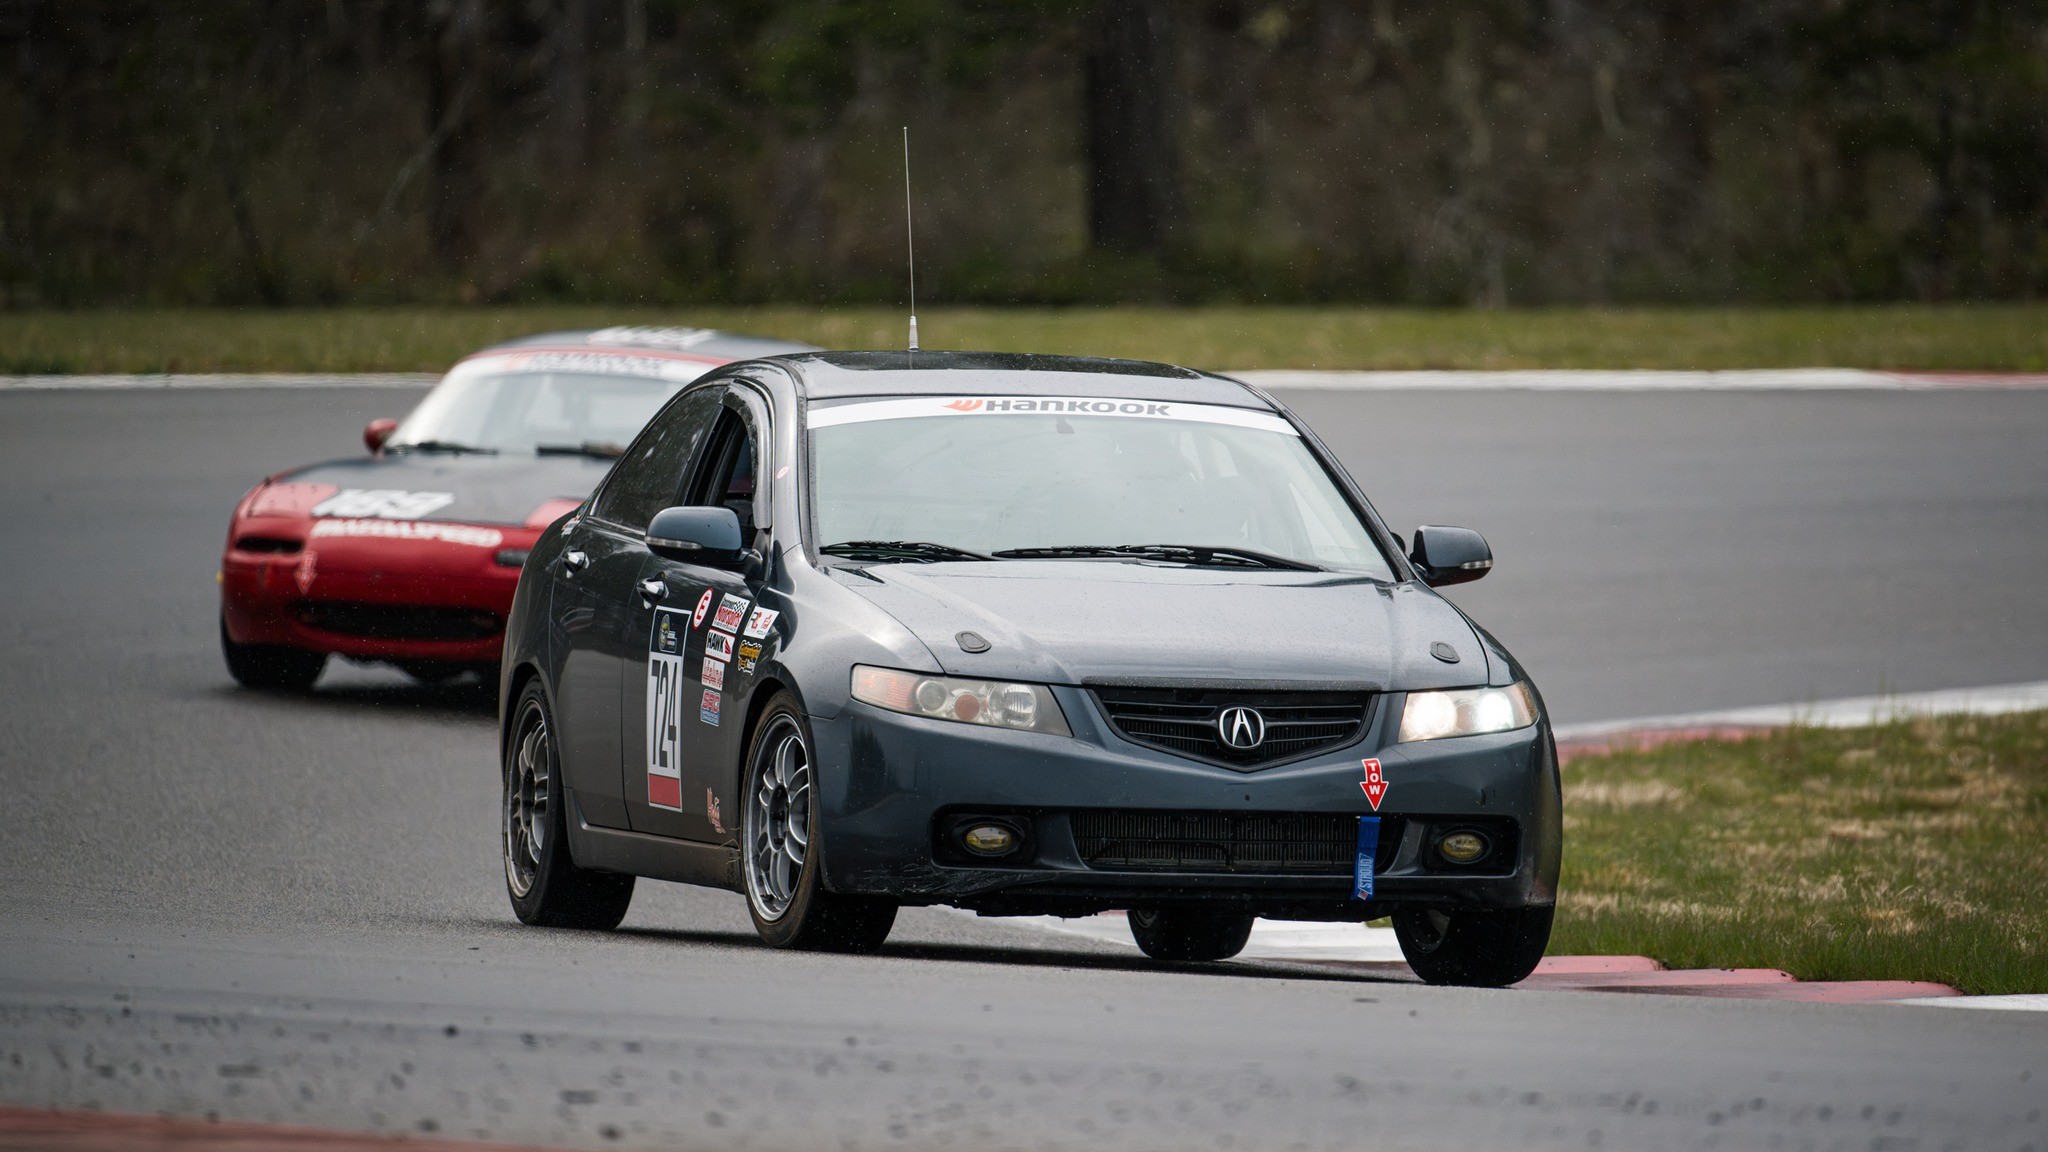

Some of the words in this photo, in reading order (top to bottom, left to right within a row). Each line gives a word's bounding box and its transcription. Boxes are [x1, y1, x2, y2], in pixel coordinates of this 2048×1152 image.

[706, 631, 725, 654] HAWK
[652, 659, 678, 770] 724
[1367, 762, 1381, 796] TOW
[1359, 857, 1373, 890] STROUD
